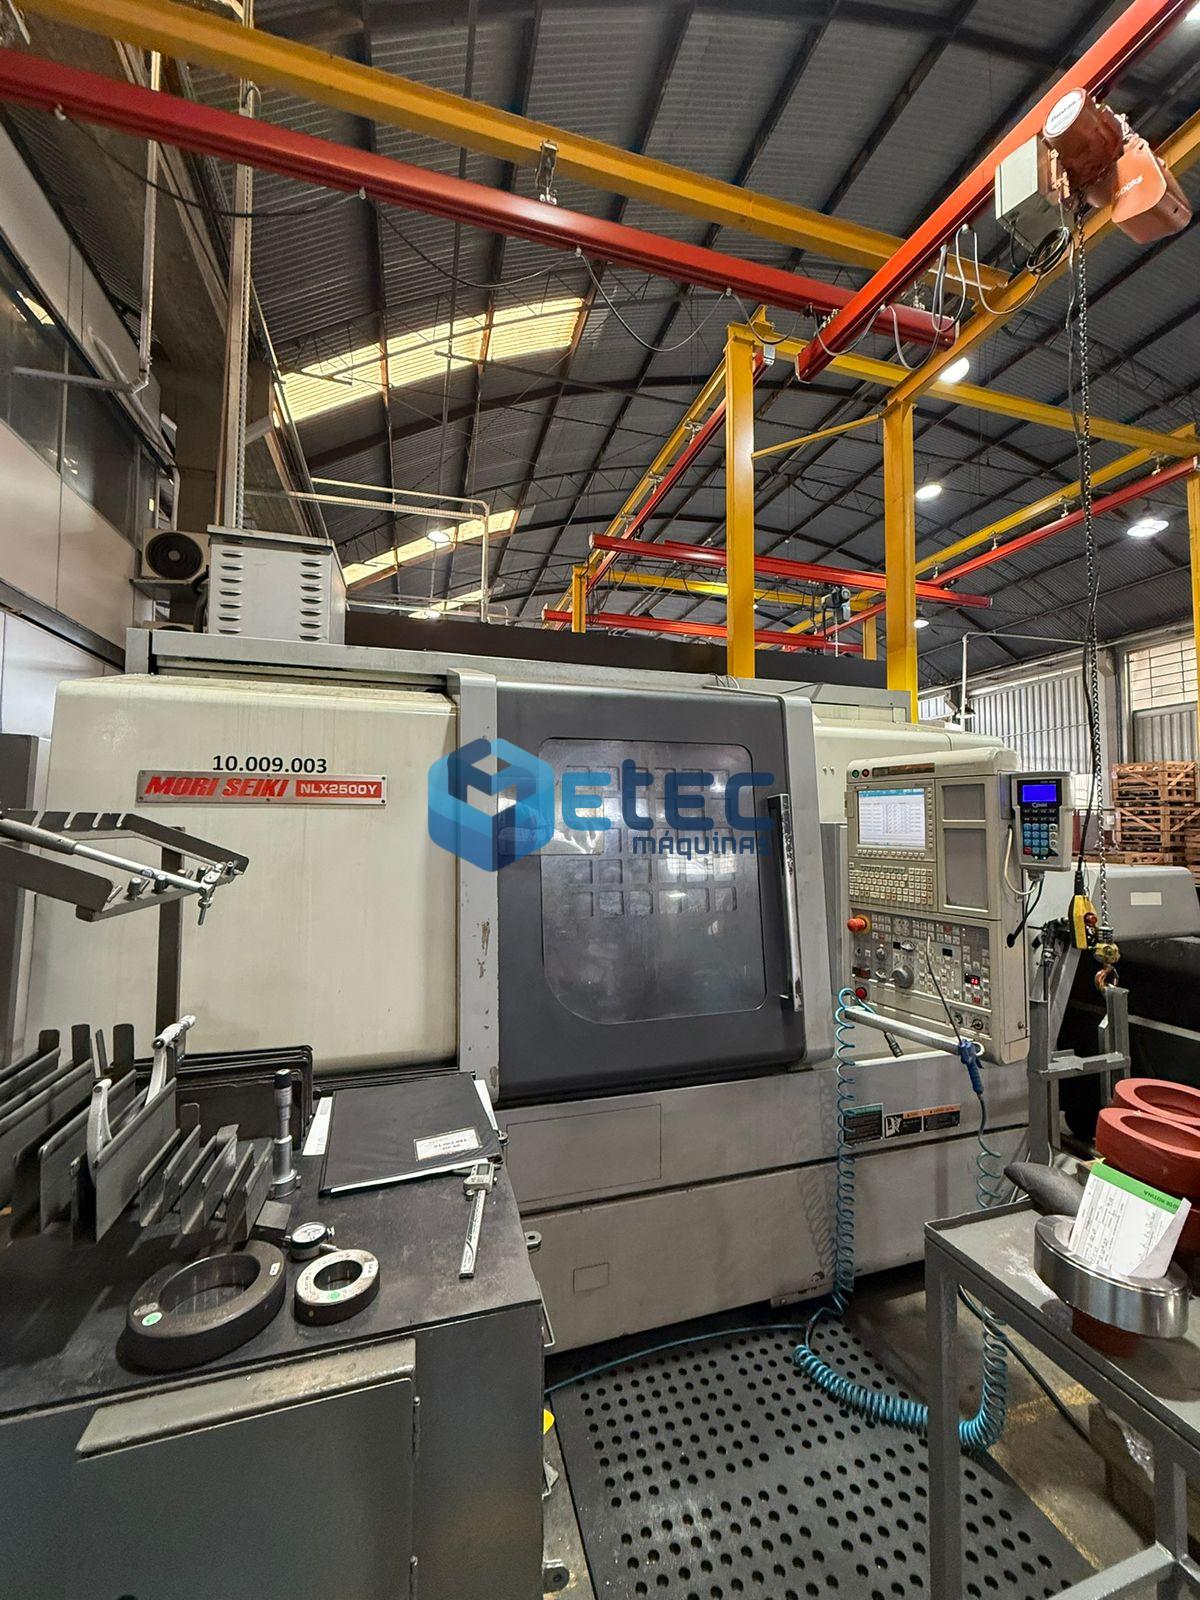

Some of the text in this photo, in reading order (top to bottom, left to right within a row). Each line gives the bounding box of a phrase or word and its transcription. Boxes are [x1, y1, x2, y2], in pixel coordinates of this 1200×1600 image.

[213, 755, 328, 773] 10.009.003
[145, 776, 378, 798] MORI SEIKI NLX2500Y
